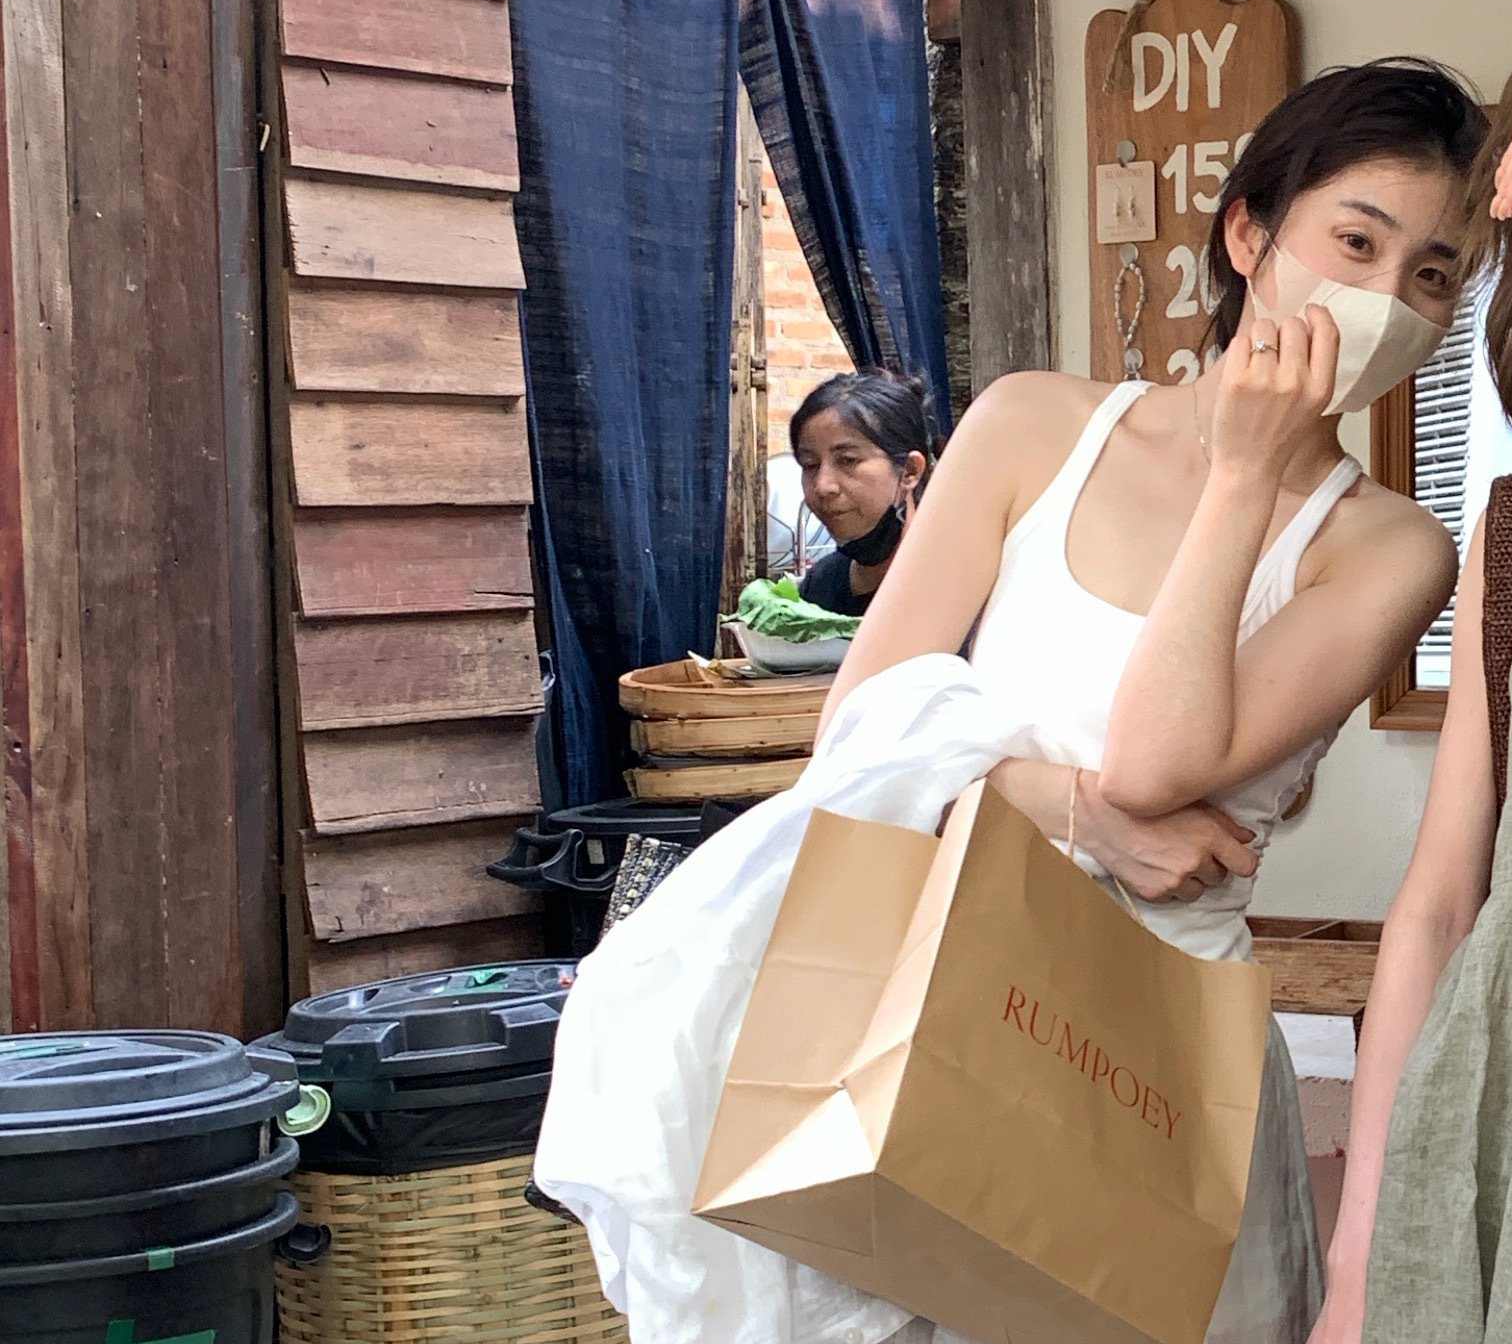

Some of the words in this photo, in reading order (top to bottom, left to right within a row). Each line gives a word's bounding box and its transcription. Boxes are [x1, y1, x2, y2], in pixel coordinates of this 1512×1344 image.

[1131, 22, 1238, 113] DIY
[1161, 132, 1255, 215] 15
[1002, 984, 1181, 1140] RUMPOEY
